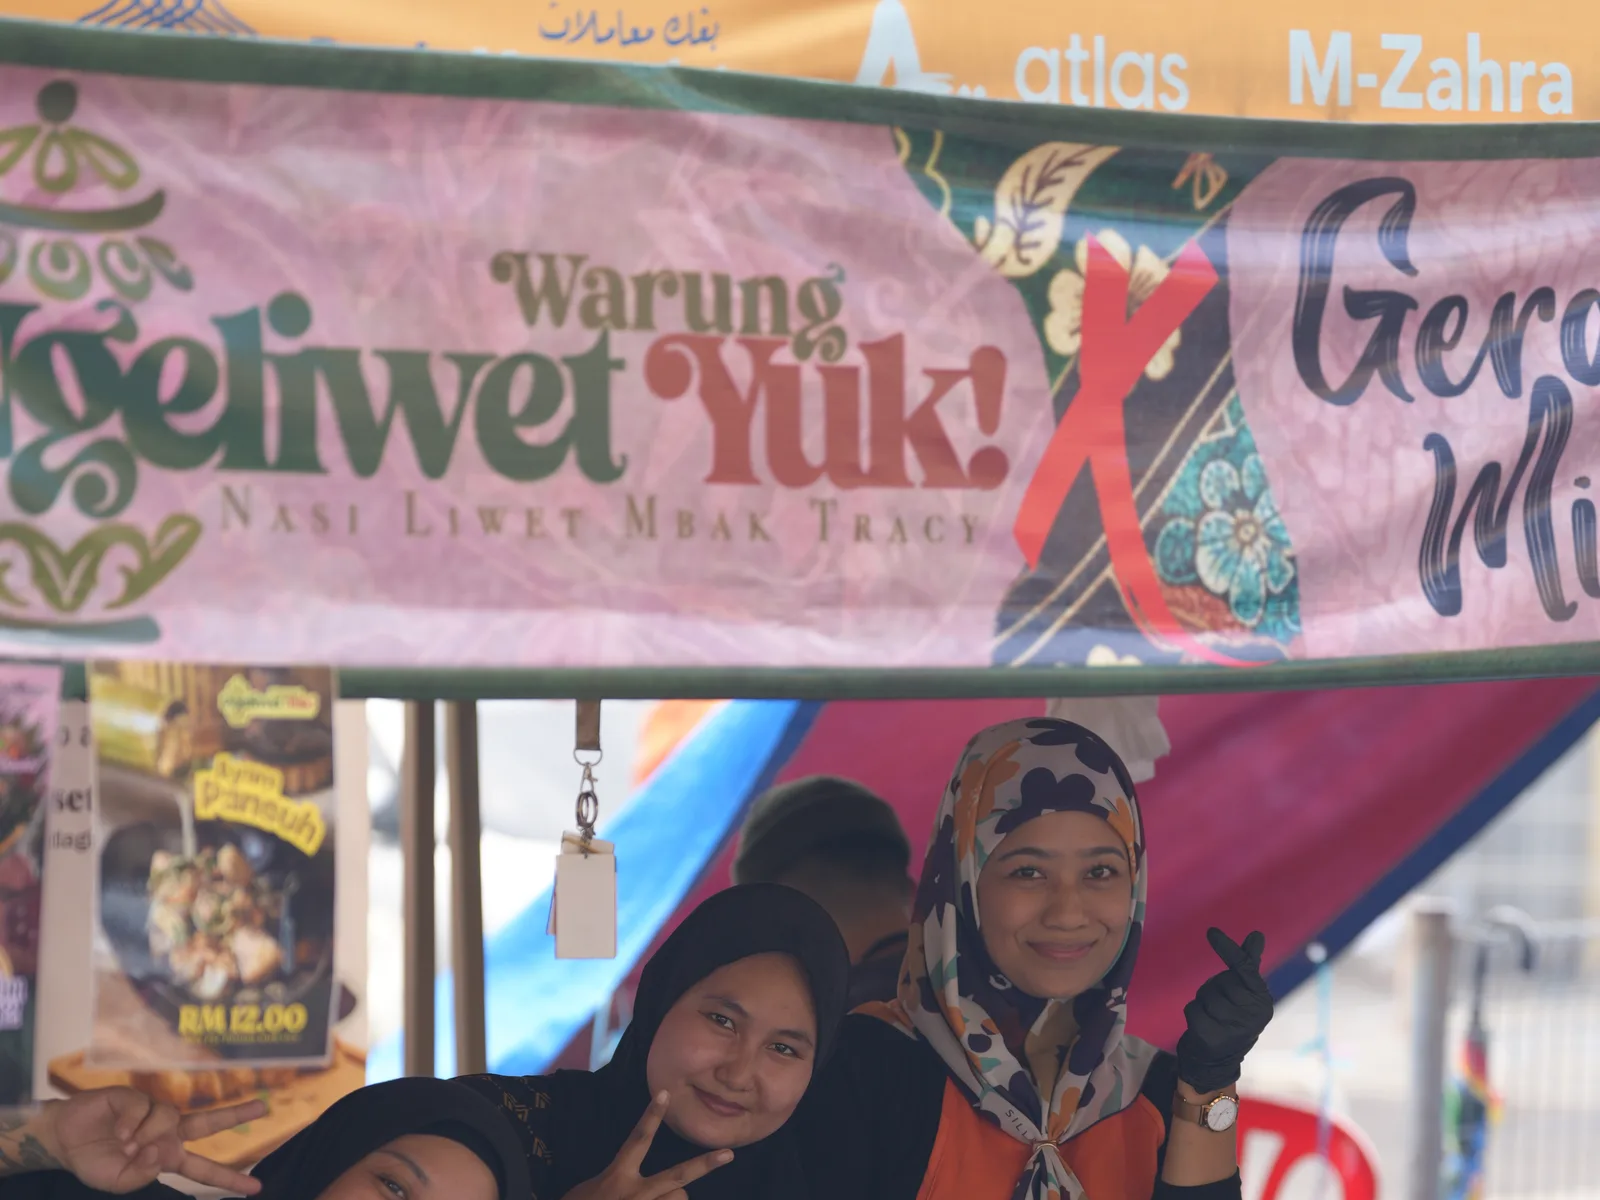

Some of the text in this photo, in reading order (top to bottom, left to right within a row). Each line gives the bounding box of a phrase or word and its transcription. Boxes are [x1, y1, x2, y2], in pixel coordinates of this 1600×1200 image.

[1014, 33, 1190, 110] atlas
[1287, 29, 1574, 116] M-Zahra
[490, 250, 850, 363] Warung
[0, 291, 628, 519] geliwet
[643, 332, 1010, 491] Yuk!
[179, 1002, 308, 1036] RM 12.00
[1005, 1109, 1037, 1142] SILL
